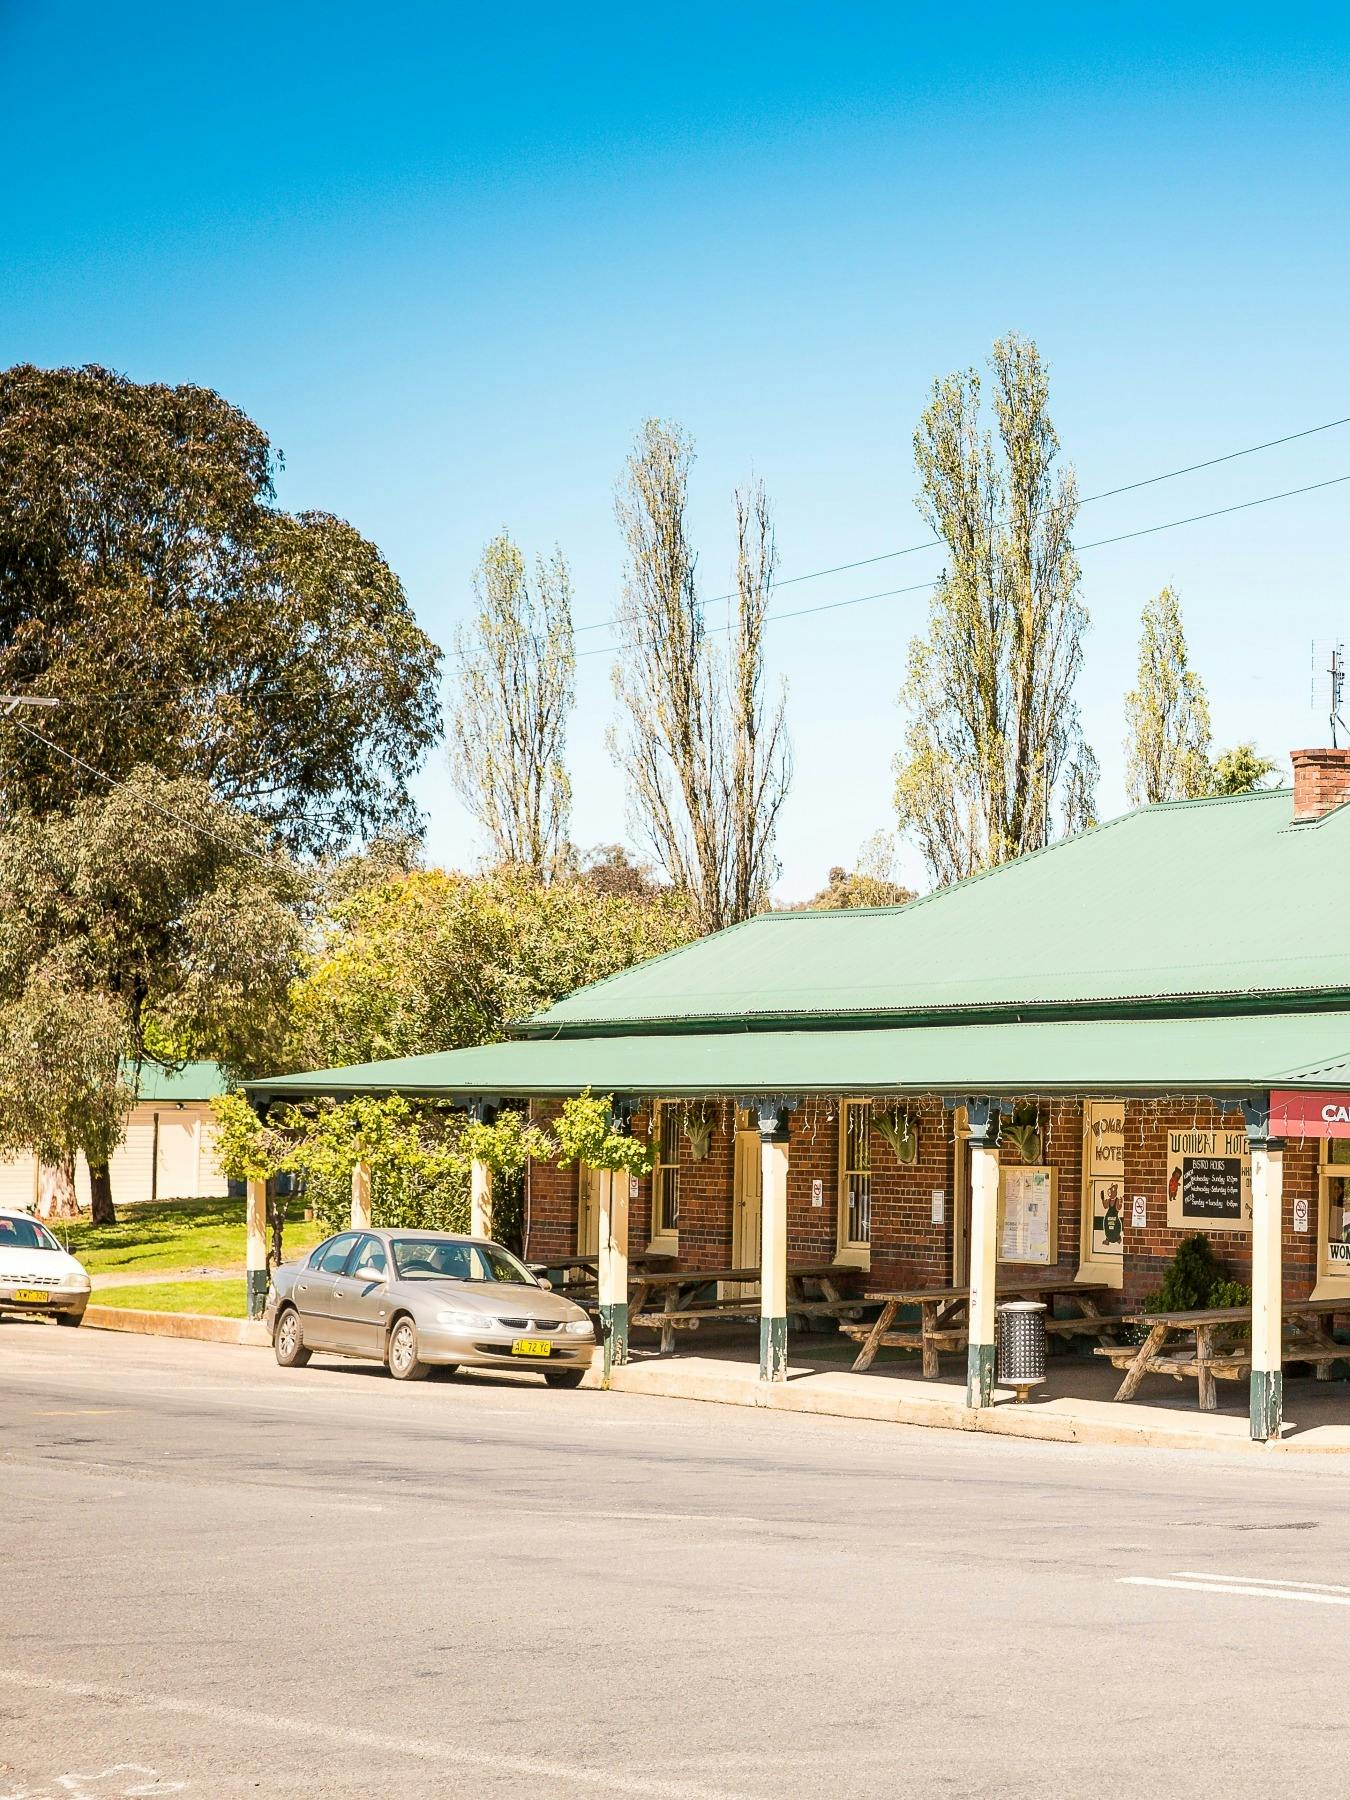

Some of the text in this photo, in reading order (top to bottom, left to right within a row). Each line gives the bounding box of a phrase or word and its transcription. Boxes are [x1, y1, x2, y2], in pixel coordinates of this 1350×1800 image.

[1170, 1133, 1217, 1154] WOMBAT
[1192, 1160, 1225, 1171] BISTRO HOURS
[528, 1343, 537, 1352] 72
